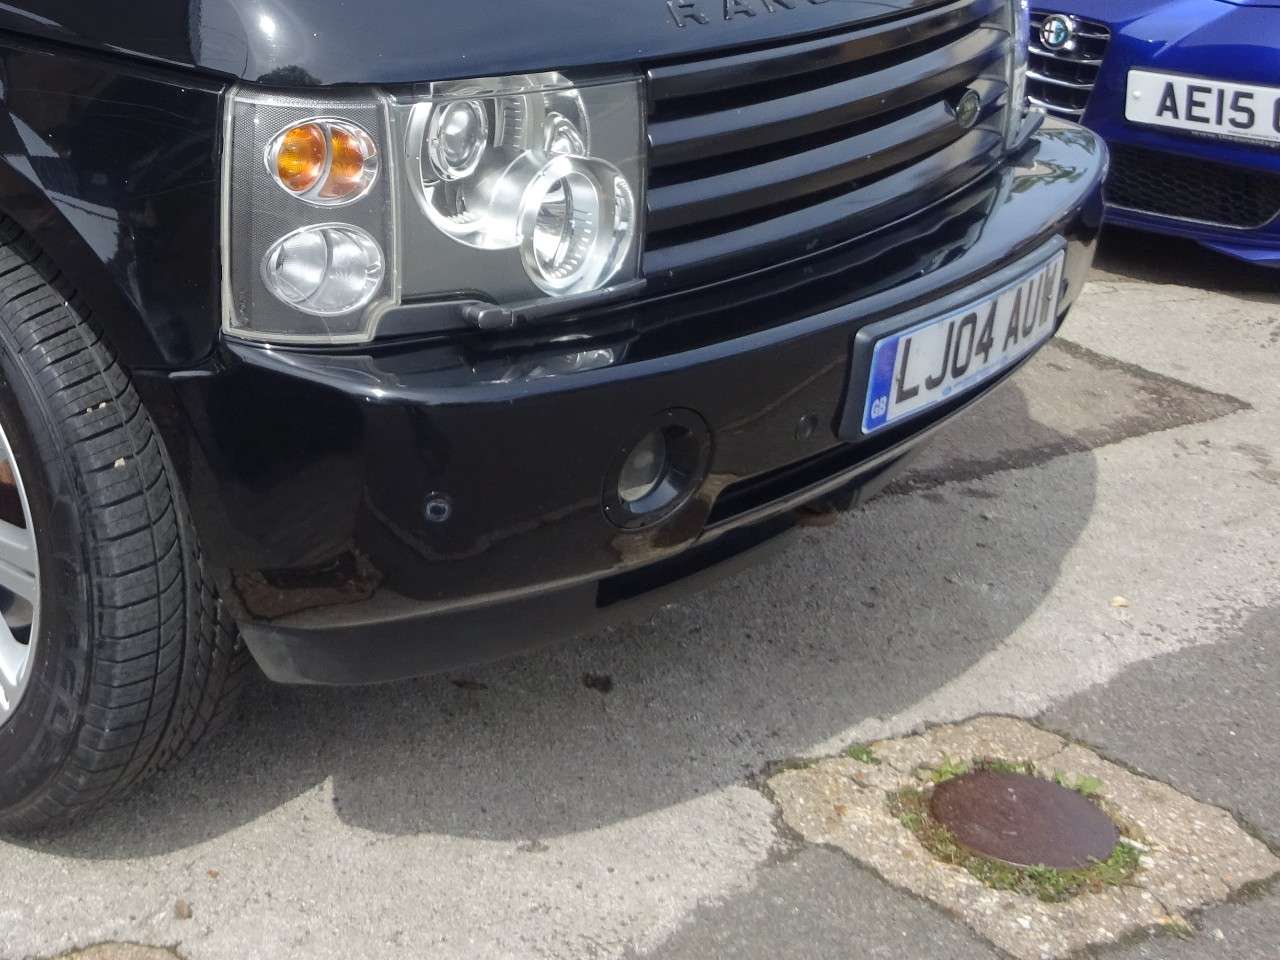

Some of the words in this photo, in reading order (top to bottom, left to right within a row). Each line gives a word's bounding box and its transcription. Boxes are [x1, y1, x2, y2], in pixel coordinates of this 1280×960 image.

[1155, 81, 1256, 130] AE15
[895, 298, 998, 405] LJ04
[870, 396, 887, 419] GB
